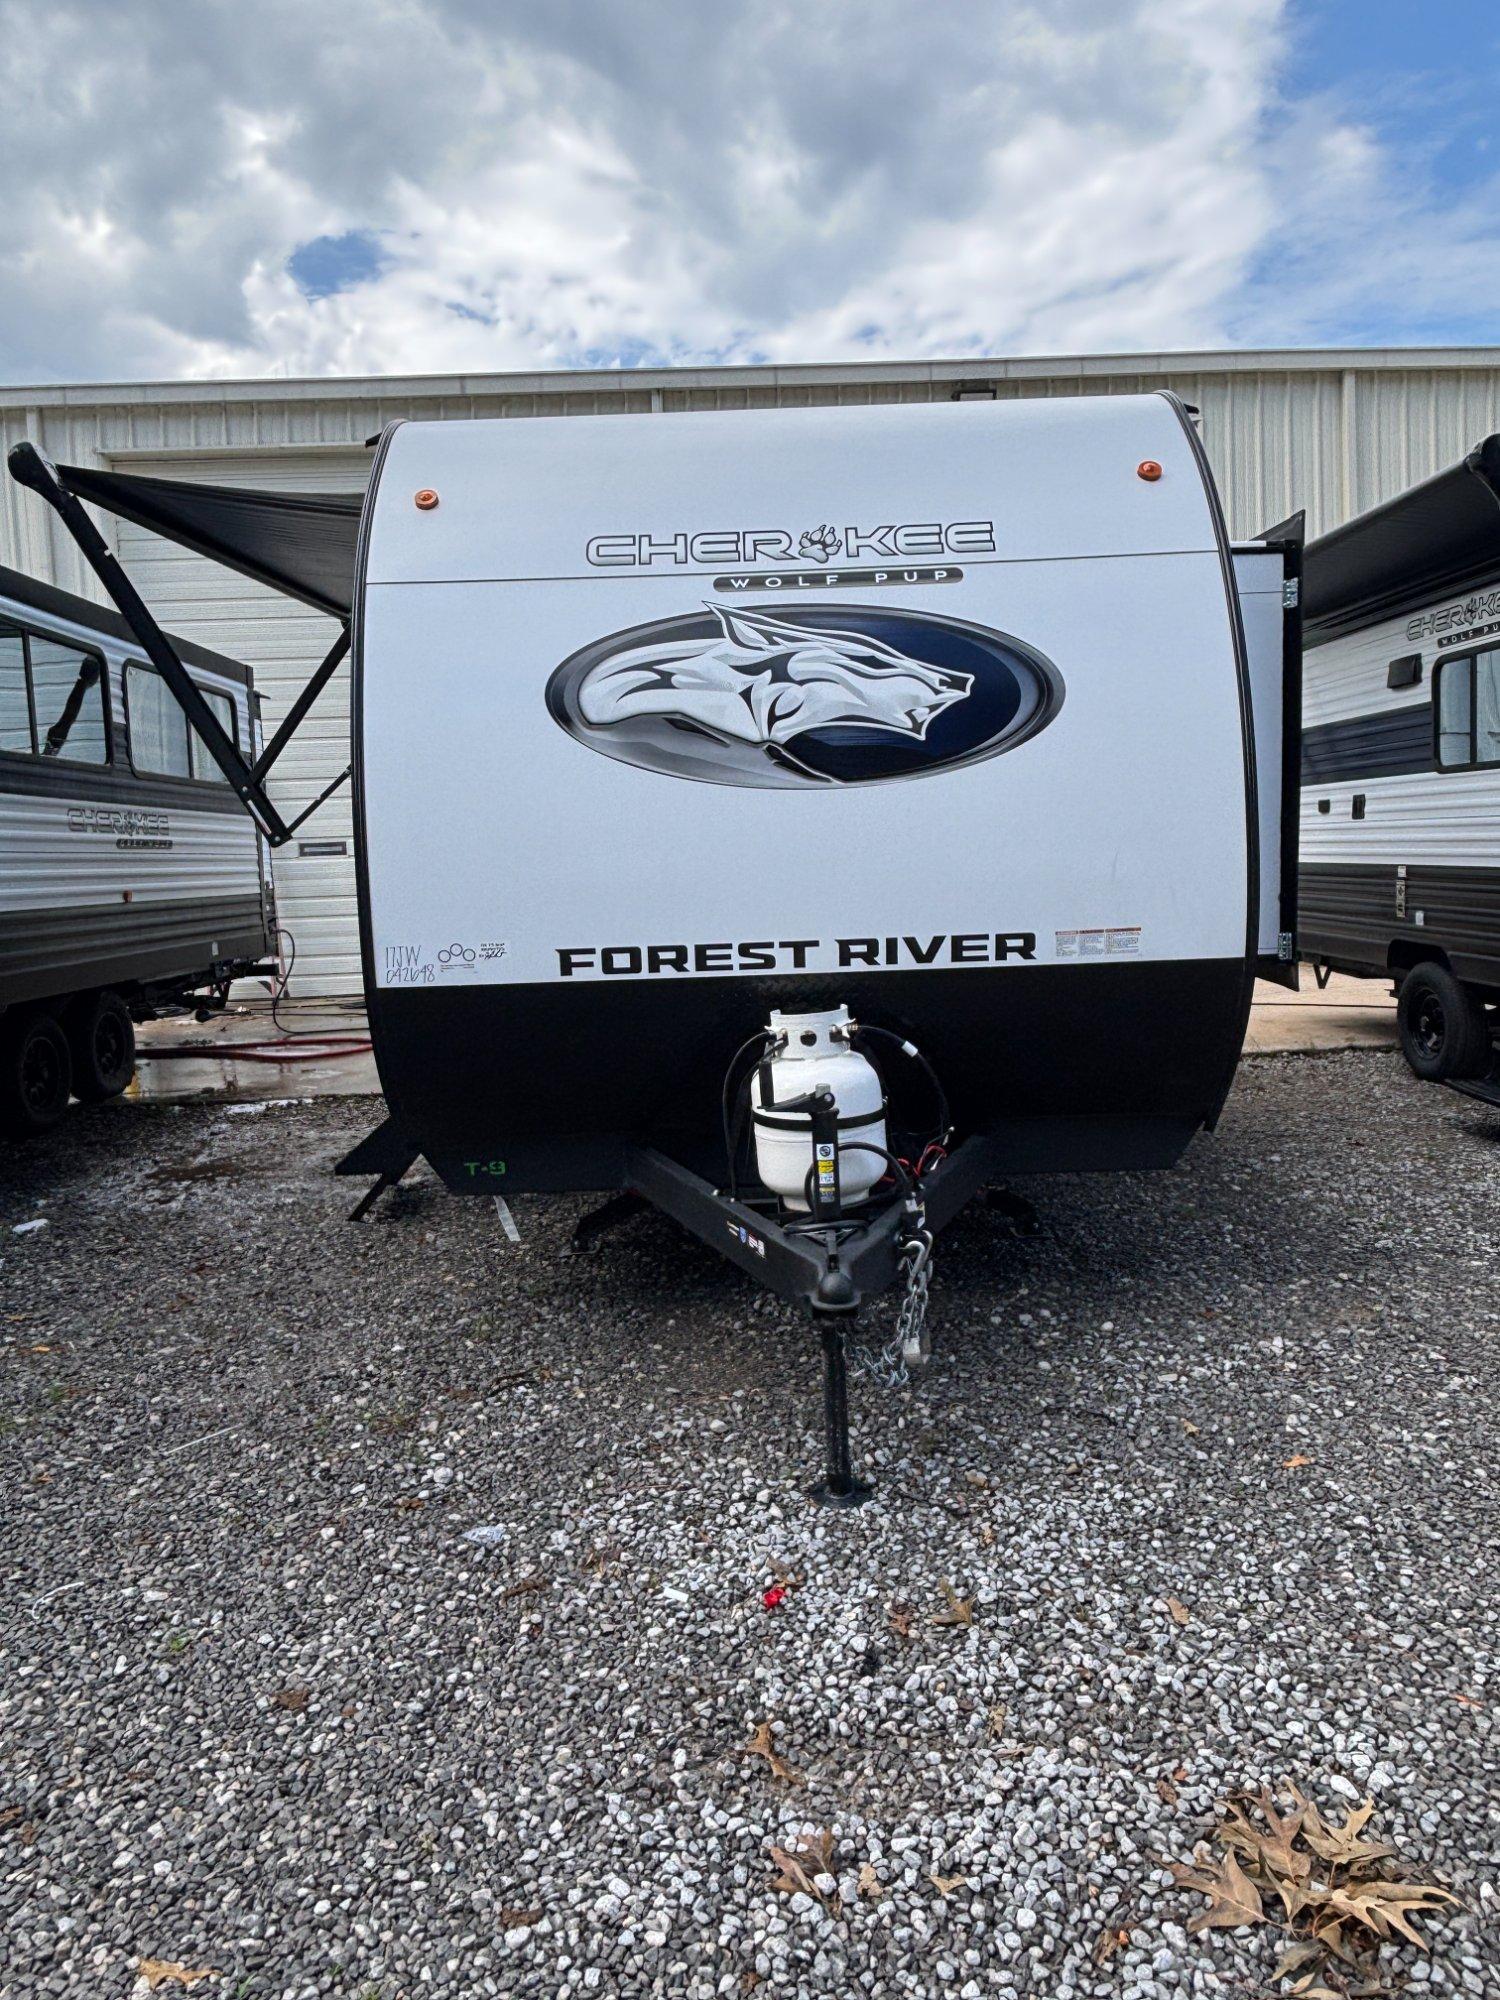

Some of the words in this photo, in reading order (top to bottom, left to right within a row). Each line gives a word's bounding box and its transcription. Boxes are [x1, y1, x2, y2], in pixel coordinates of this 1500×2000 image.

[730, 574, 839, 590] WOLF
[875, 570, 949, 584] PUP
[1441, 630, 1475, 645] WOLF
[555, 940, 820, 977] FOREST
[834, 932, 1038, 967] RIVER
